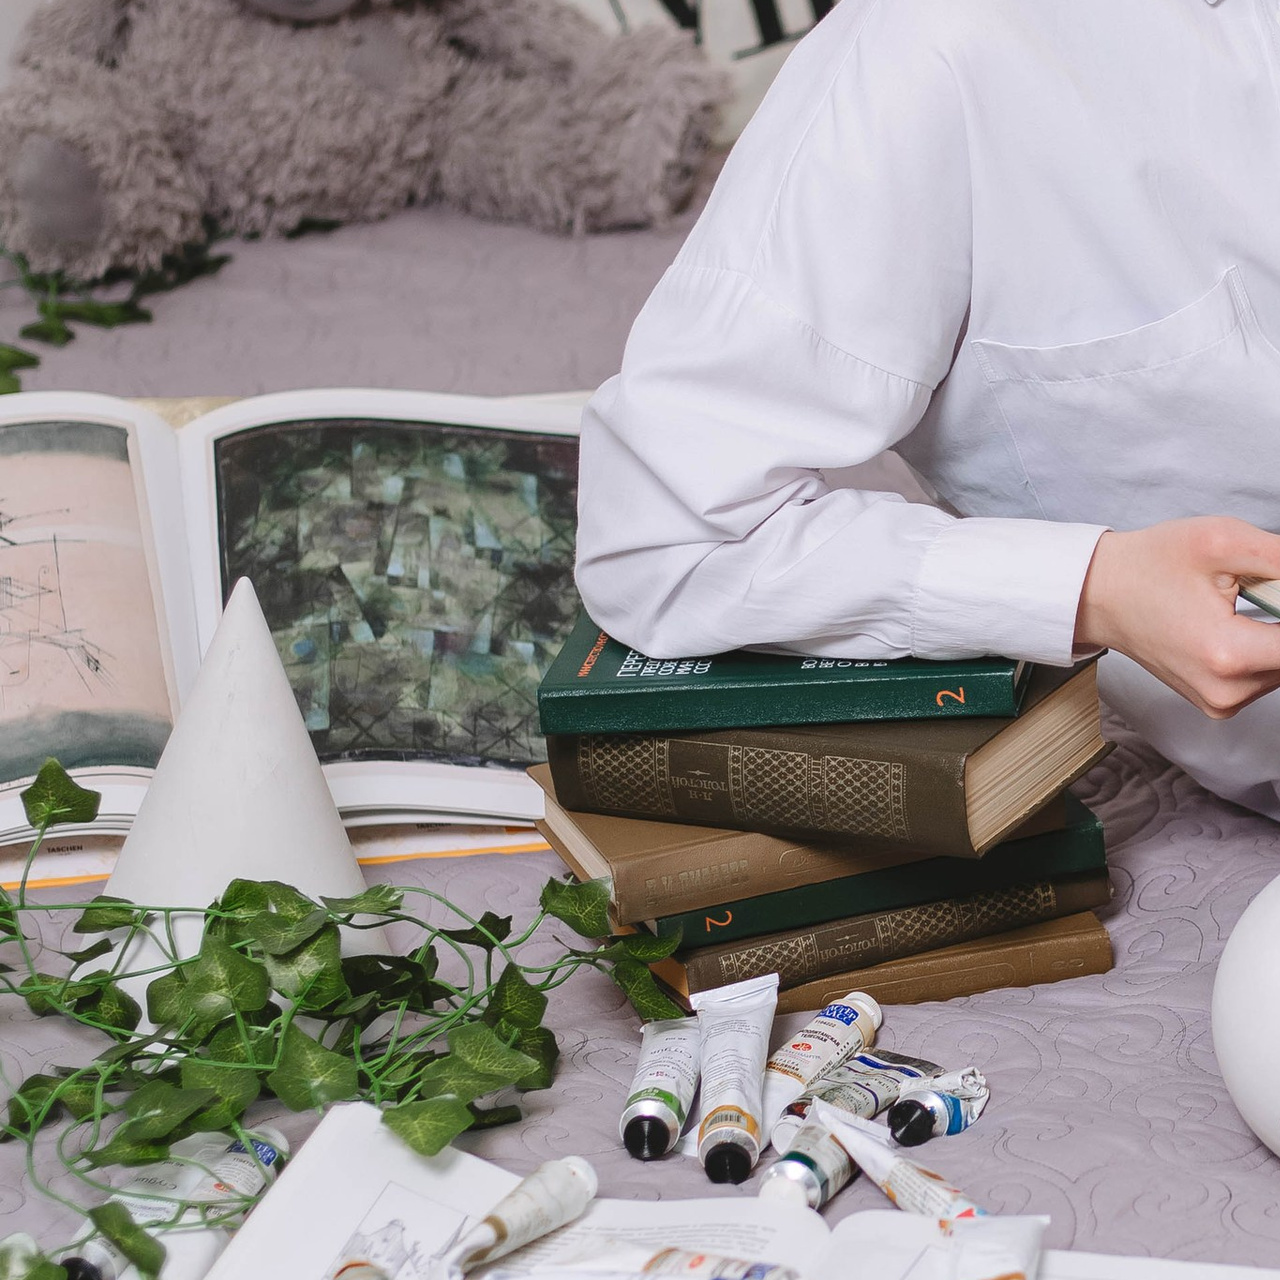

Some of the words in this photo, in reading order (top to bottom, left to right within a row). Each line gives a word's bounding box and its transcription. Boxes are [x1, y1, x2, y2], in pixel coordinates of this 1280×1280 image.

[936, 686, 966, 707] 2
[671, 775, 728, 792] ТОЛСТОЙ
[47, 844, 83, 853] TASCHEN
[705, 910, 733, 932] 2
[819, 937, 880, 962] ТОЛСТОЙ
